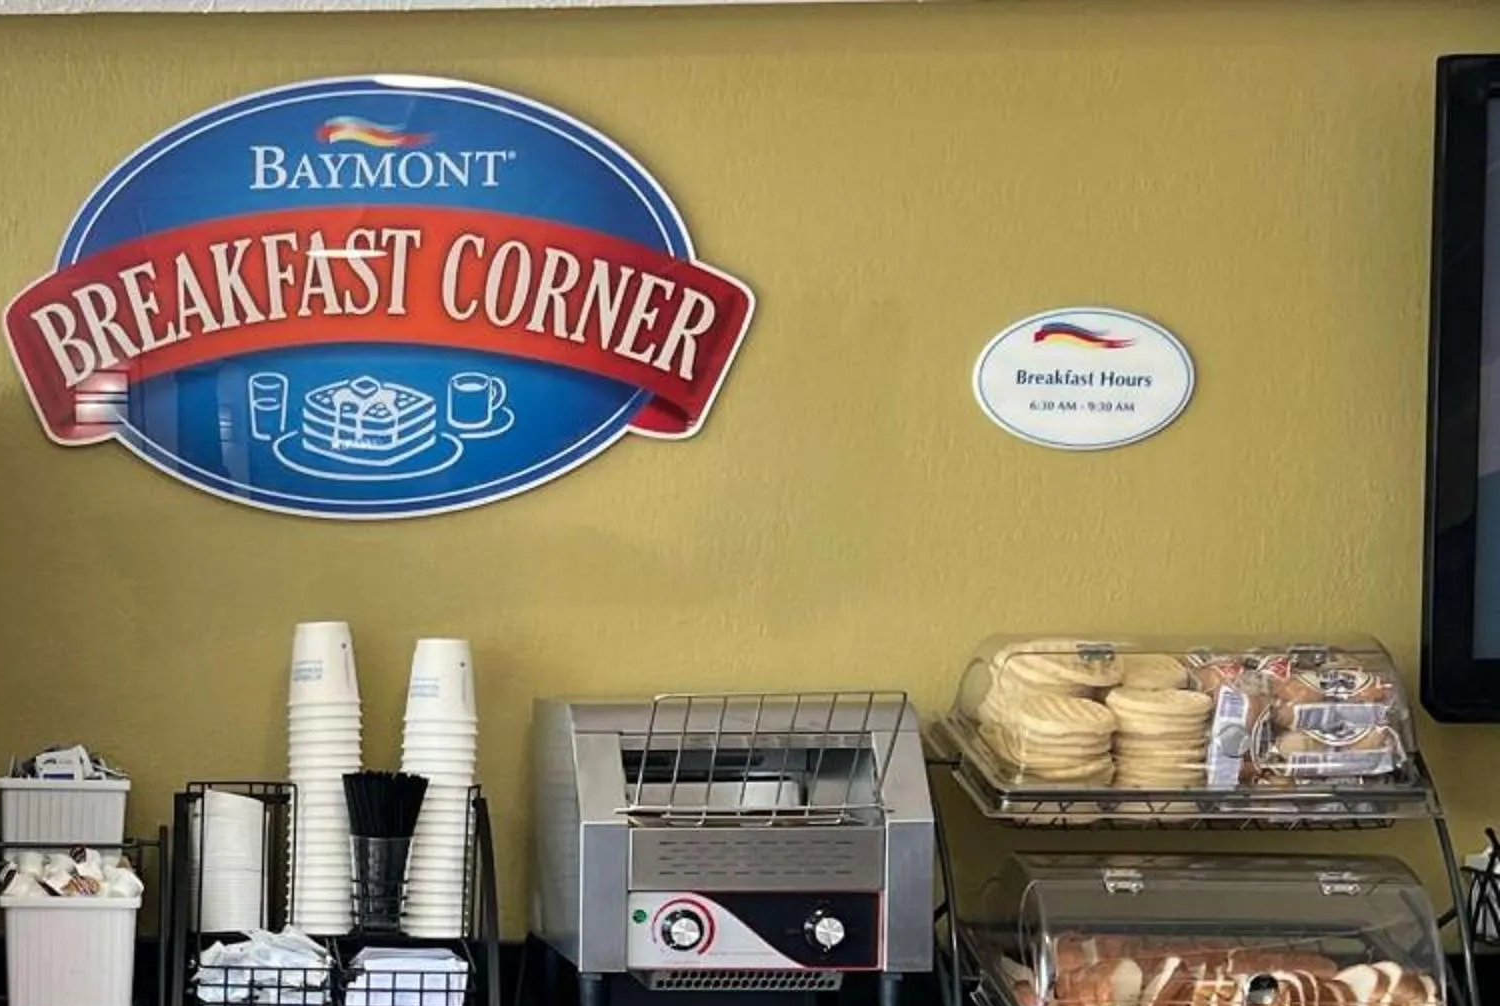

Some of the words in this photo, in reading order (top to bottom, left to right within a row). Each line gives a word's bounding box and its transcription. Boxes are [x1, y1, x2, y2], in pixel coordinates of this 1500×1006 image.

[250, 145, 508, 191] BAYMONT
[30, 227, 421, 389] BREAKFAST
[442, 232, 717, 382] CORNER
[1015, 369, 1095, 387] Breakfast
[1100, 371, 1153, 388] Hours
[1029, 400, 1055, 411] 6:30
[1057, 400, 1078, 411] AM
[1087, 401, 1113, 412] 9:30
[1114, 401, 1135, 412] AM
